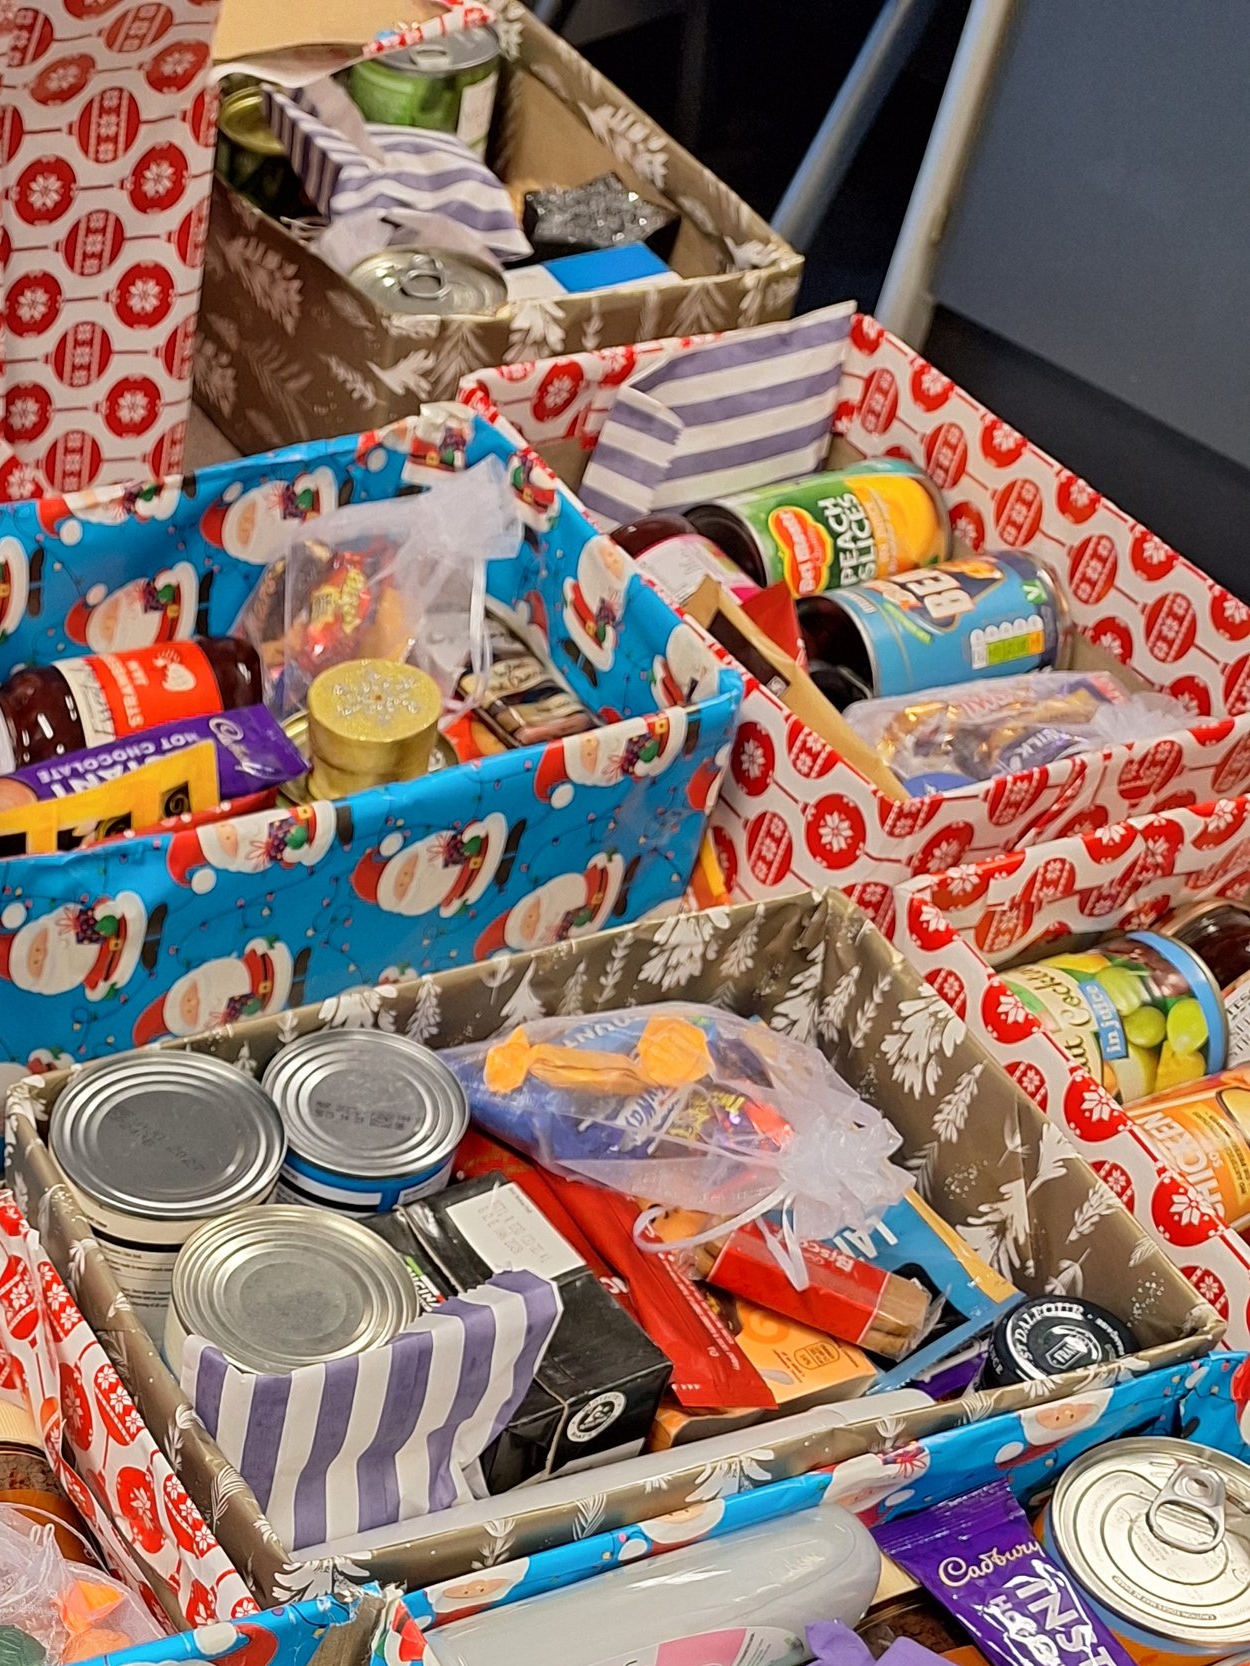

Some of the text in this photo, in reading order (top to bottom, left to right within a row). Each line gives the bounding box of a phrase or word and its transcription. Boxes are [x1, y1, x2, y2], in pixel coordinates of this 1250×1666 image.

[818, 496, 856, 587] PEACH
[847, 493, 876, 583] SLICES
[36, 740, 157, 785] CHOCOLATE
[1106, 1030, 1122, 1053] in
[1014, 1302, 1085, 1345] DALFOUR
[938, 1541, 1043, 1588] Cadbury
